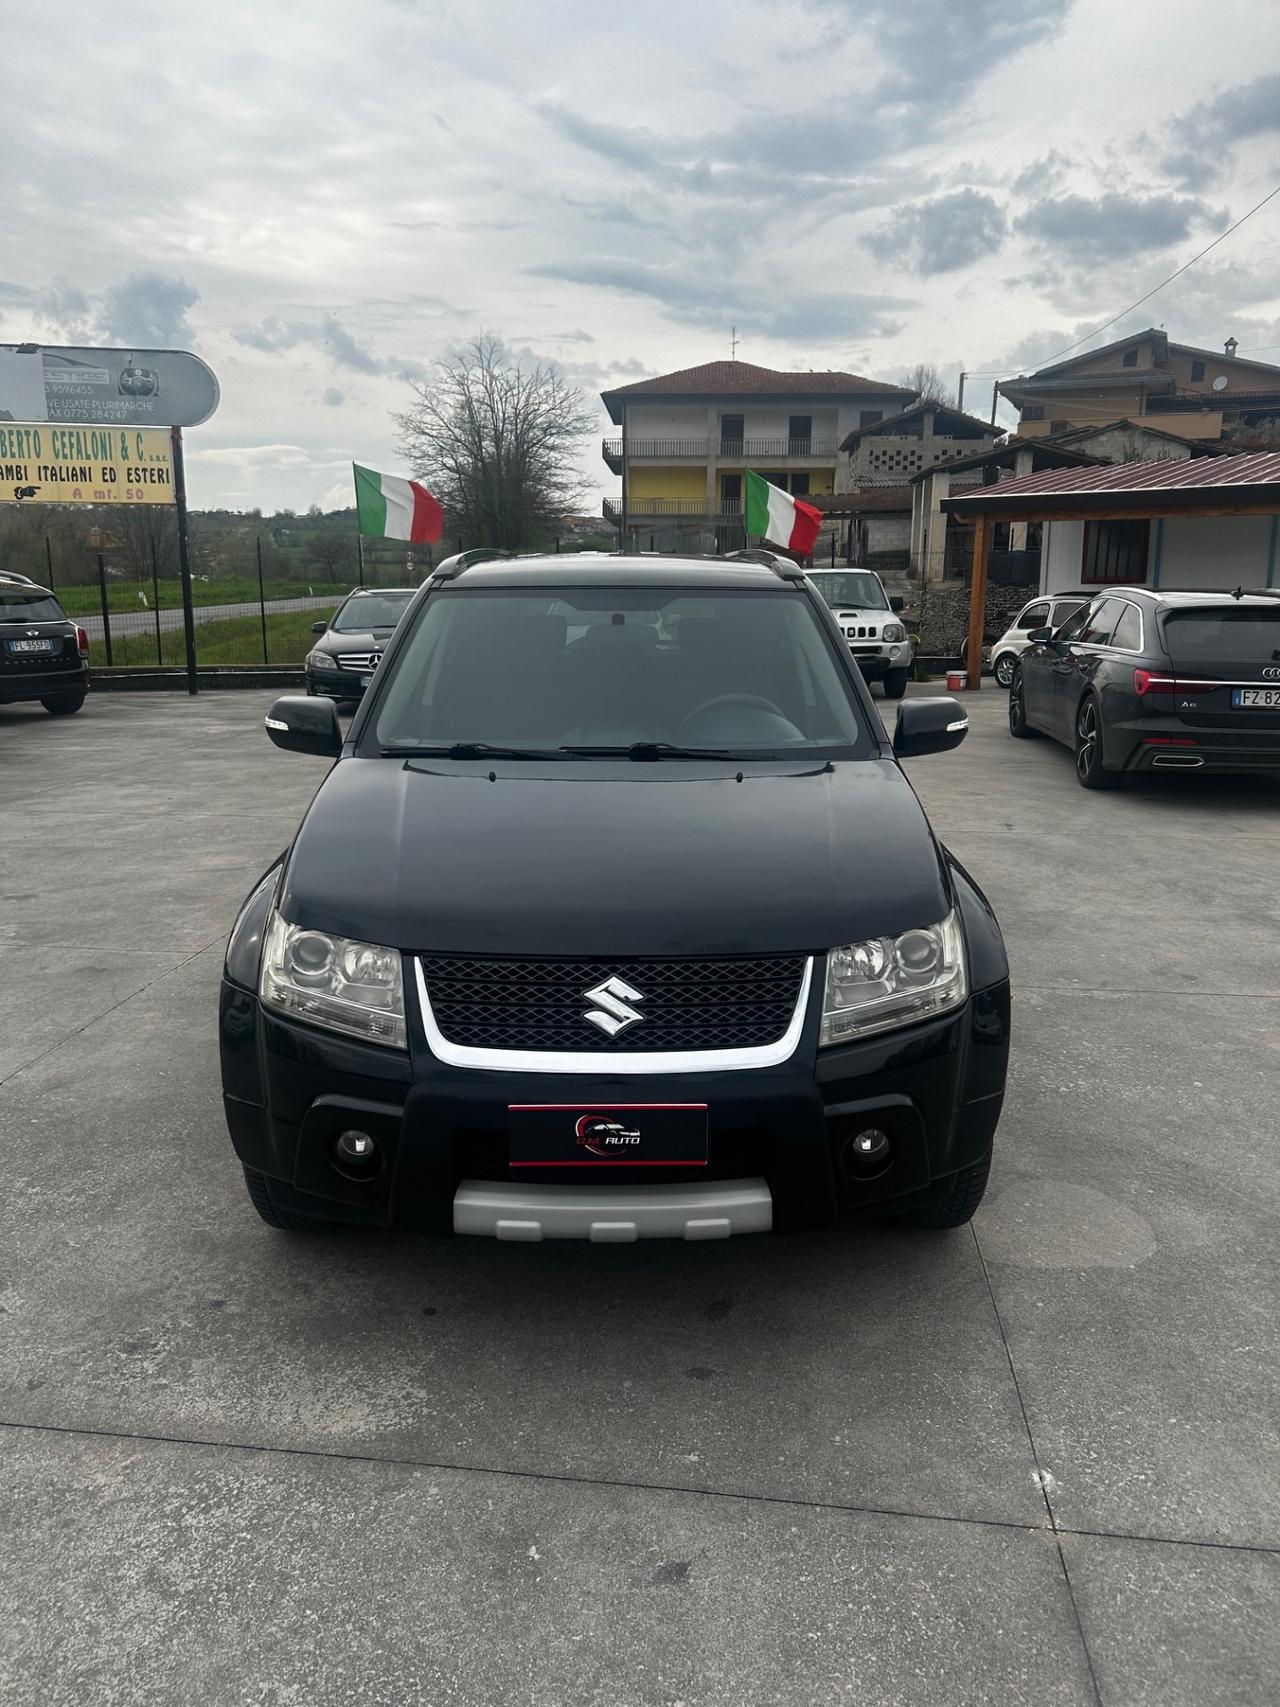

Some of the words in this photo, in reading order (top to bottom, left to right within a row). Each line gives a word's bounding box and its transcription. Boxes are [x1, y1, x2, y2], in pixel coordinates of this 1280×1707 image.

[61, 399, 91, 409] USATE
[92, 399, 155, 412] PLURIMARCHE
[63, 409, 89, 418] 0775
[91, 409, 127, 419] 284247
[0, 429, 42, 459] BERTO
[52, 430, 113, 462] CEFALONI
[120, 430, 130, 462] &
[38, 465, 93, 483] ITALIANI
[102, 467, 117, 484] ED
[127, 467, 170, 485] ESTERI
[73, 488, 82, 499] A
[126, 489, 144, 500] 50
[605, 1137, 641, 1145] AUTO
